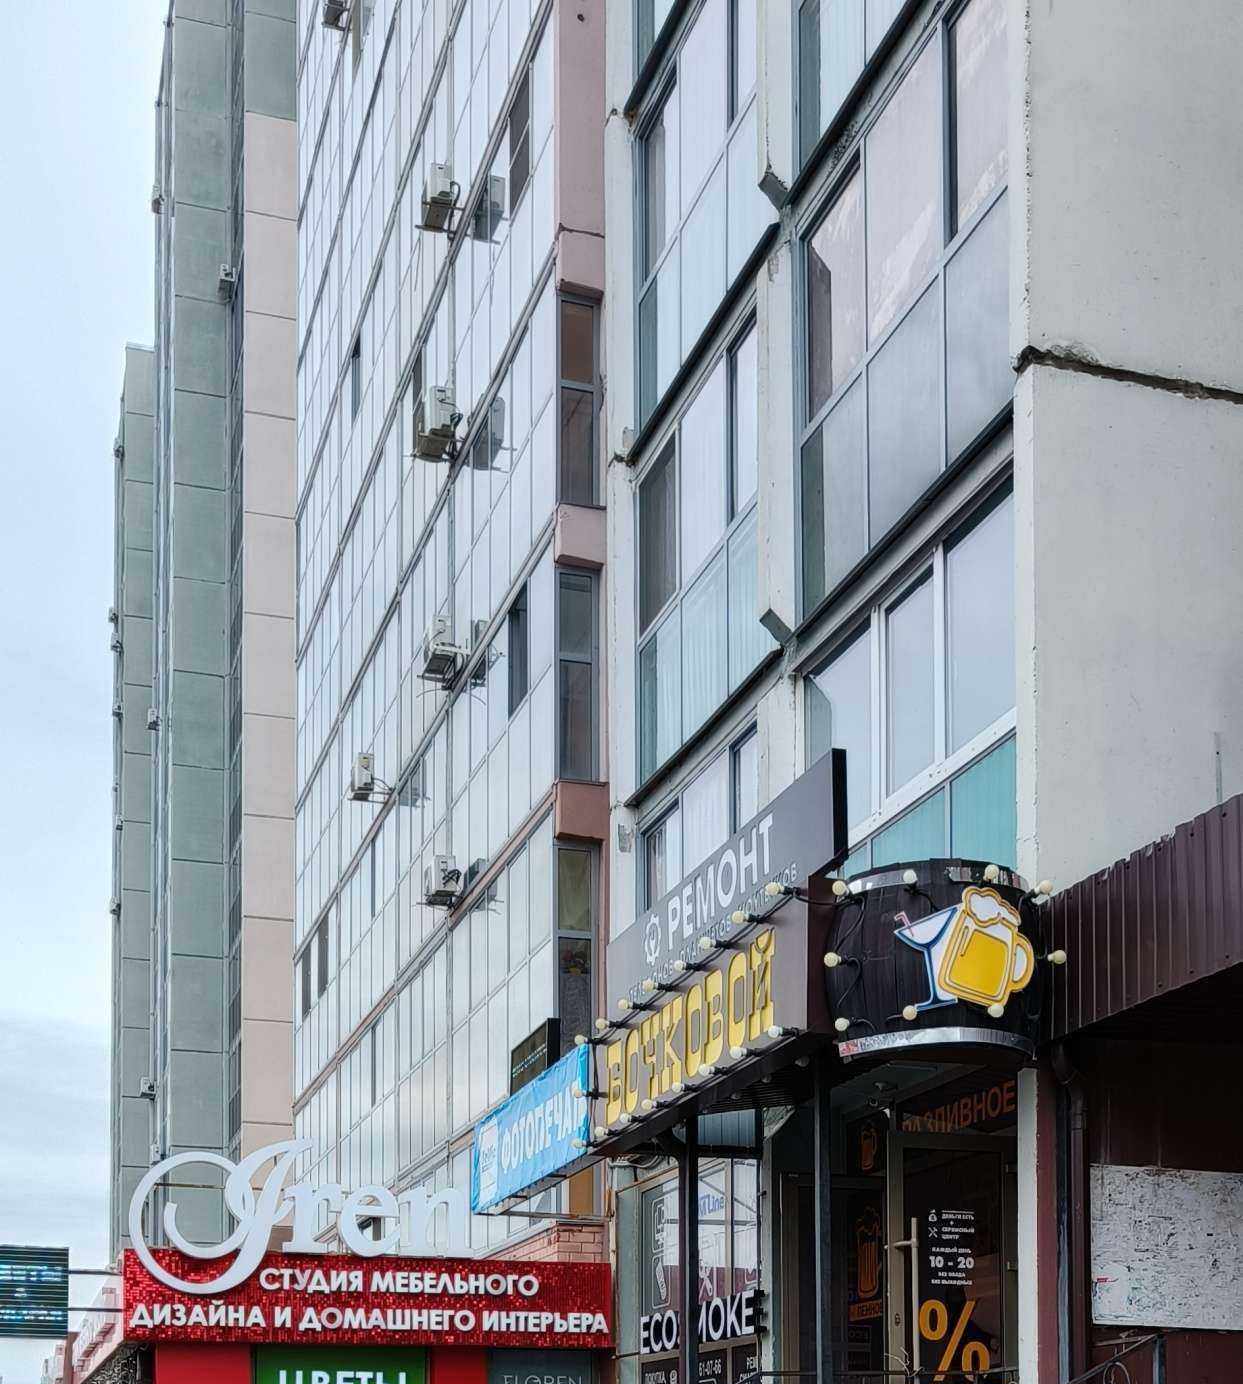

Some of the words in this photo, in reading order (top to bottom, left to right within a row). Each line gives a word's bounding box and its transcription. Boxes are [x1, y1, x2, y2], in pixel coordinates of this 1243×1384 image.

[668, 813, 773, 950] РЕМОНТ
[606, 928, 776, 1127] БОЧКОВОЙ
[929, 1255, 944, 1268] 10
[957, 1256, 975, 1269] 20
[259, 1267, 363, 1295] СТУДИЯ
[370, 1270, 540, 1298] МЕБЕЛЬНОГО
[128, 1300, 266, 1329] ДИЗАЙНА
[274, 1307, 292, 1328] И
[298, 1307, 473, 1333] ДОМАШНЕГО
[481, 1309, 610, 1335] ИНТЕРЬЕРА
